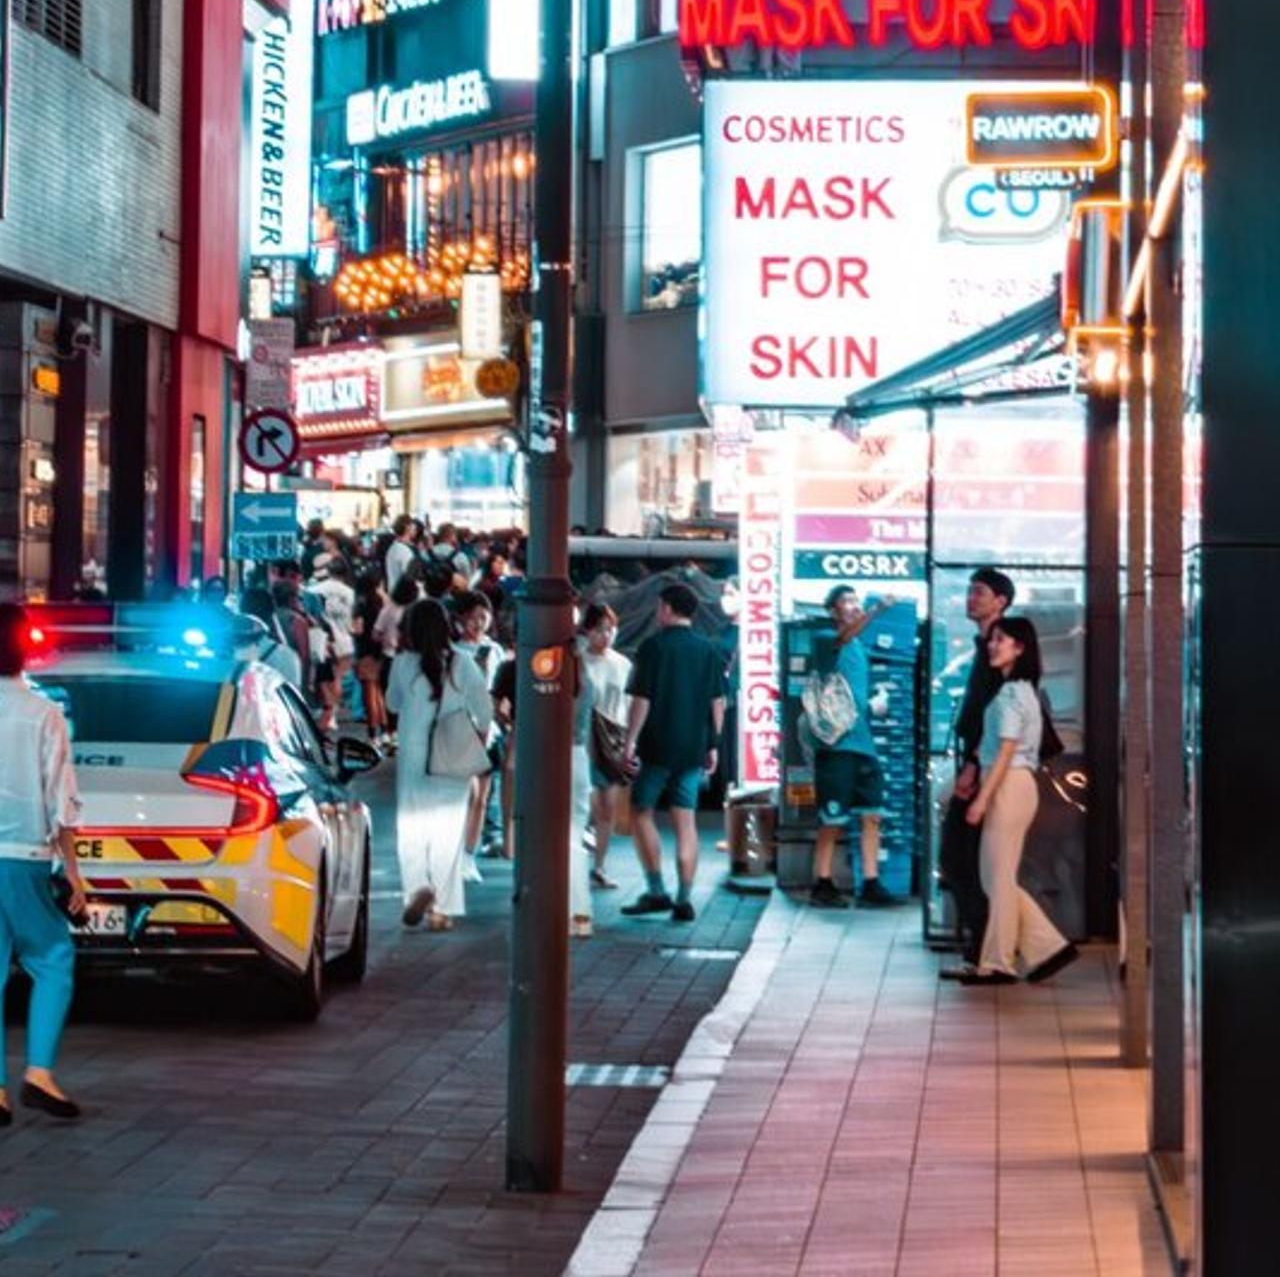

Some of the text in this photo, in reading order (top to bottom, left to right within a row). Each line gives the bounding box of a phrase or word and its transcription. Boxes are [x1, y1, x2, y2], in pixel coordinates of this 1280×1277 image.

[723, 114, 905, 144] COSMETICS
[973, 114, 1100, 140] RAWROW
[735, 175, 895, 221] MASK
[966, 183, 1040, 218] CU
[761, 256, 869, 300] FOR
[750, 335, 878, 381] SKIN
[822, 554, 909, 576] COSRX
